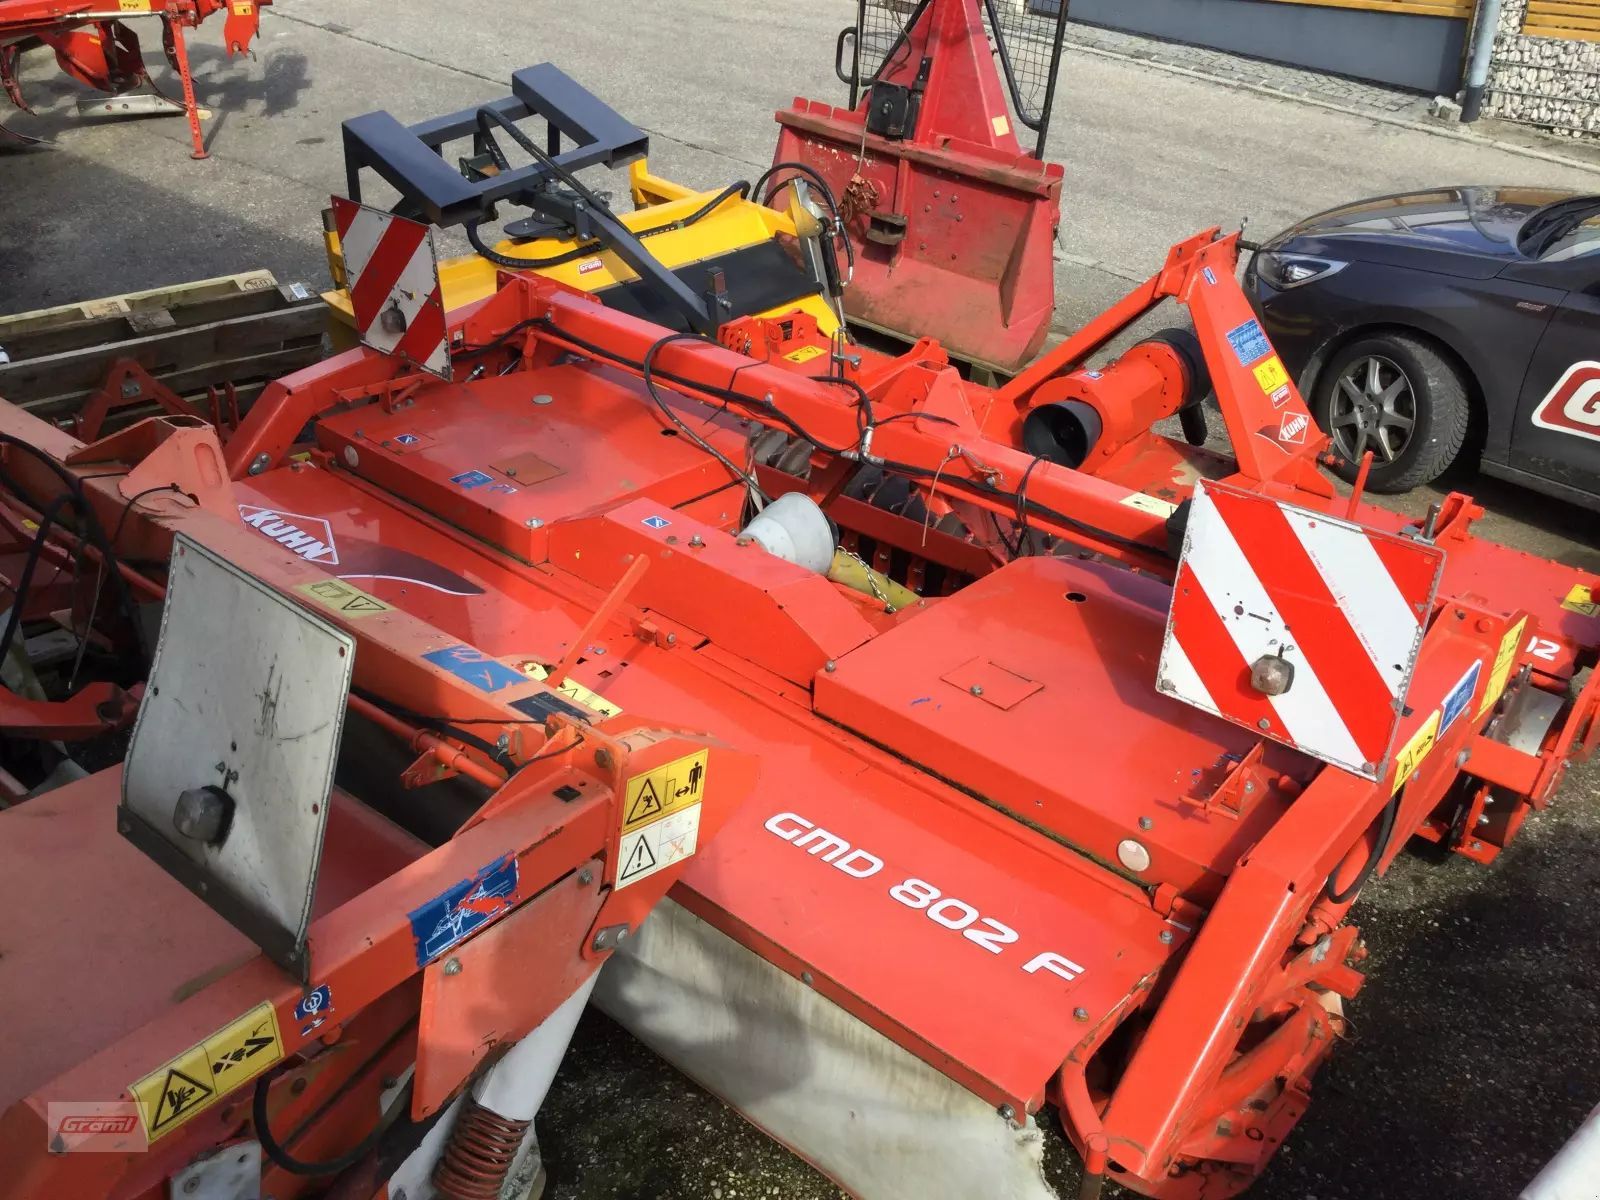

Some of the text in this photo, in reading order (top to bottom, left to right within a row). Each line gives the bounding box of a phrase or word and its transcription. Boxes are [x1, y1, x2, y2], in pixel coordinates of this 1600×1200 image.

[1281, 415, 1306, 440] KUHN
[243, 510, 334, 559] KUHN
[764, 812, 1085, 981] GMD 802 F
